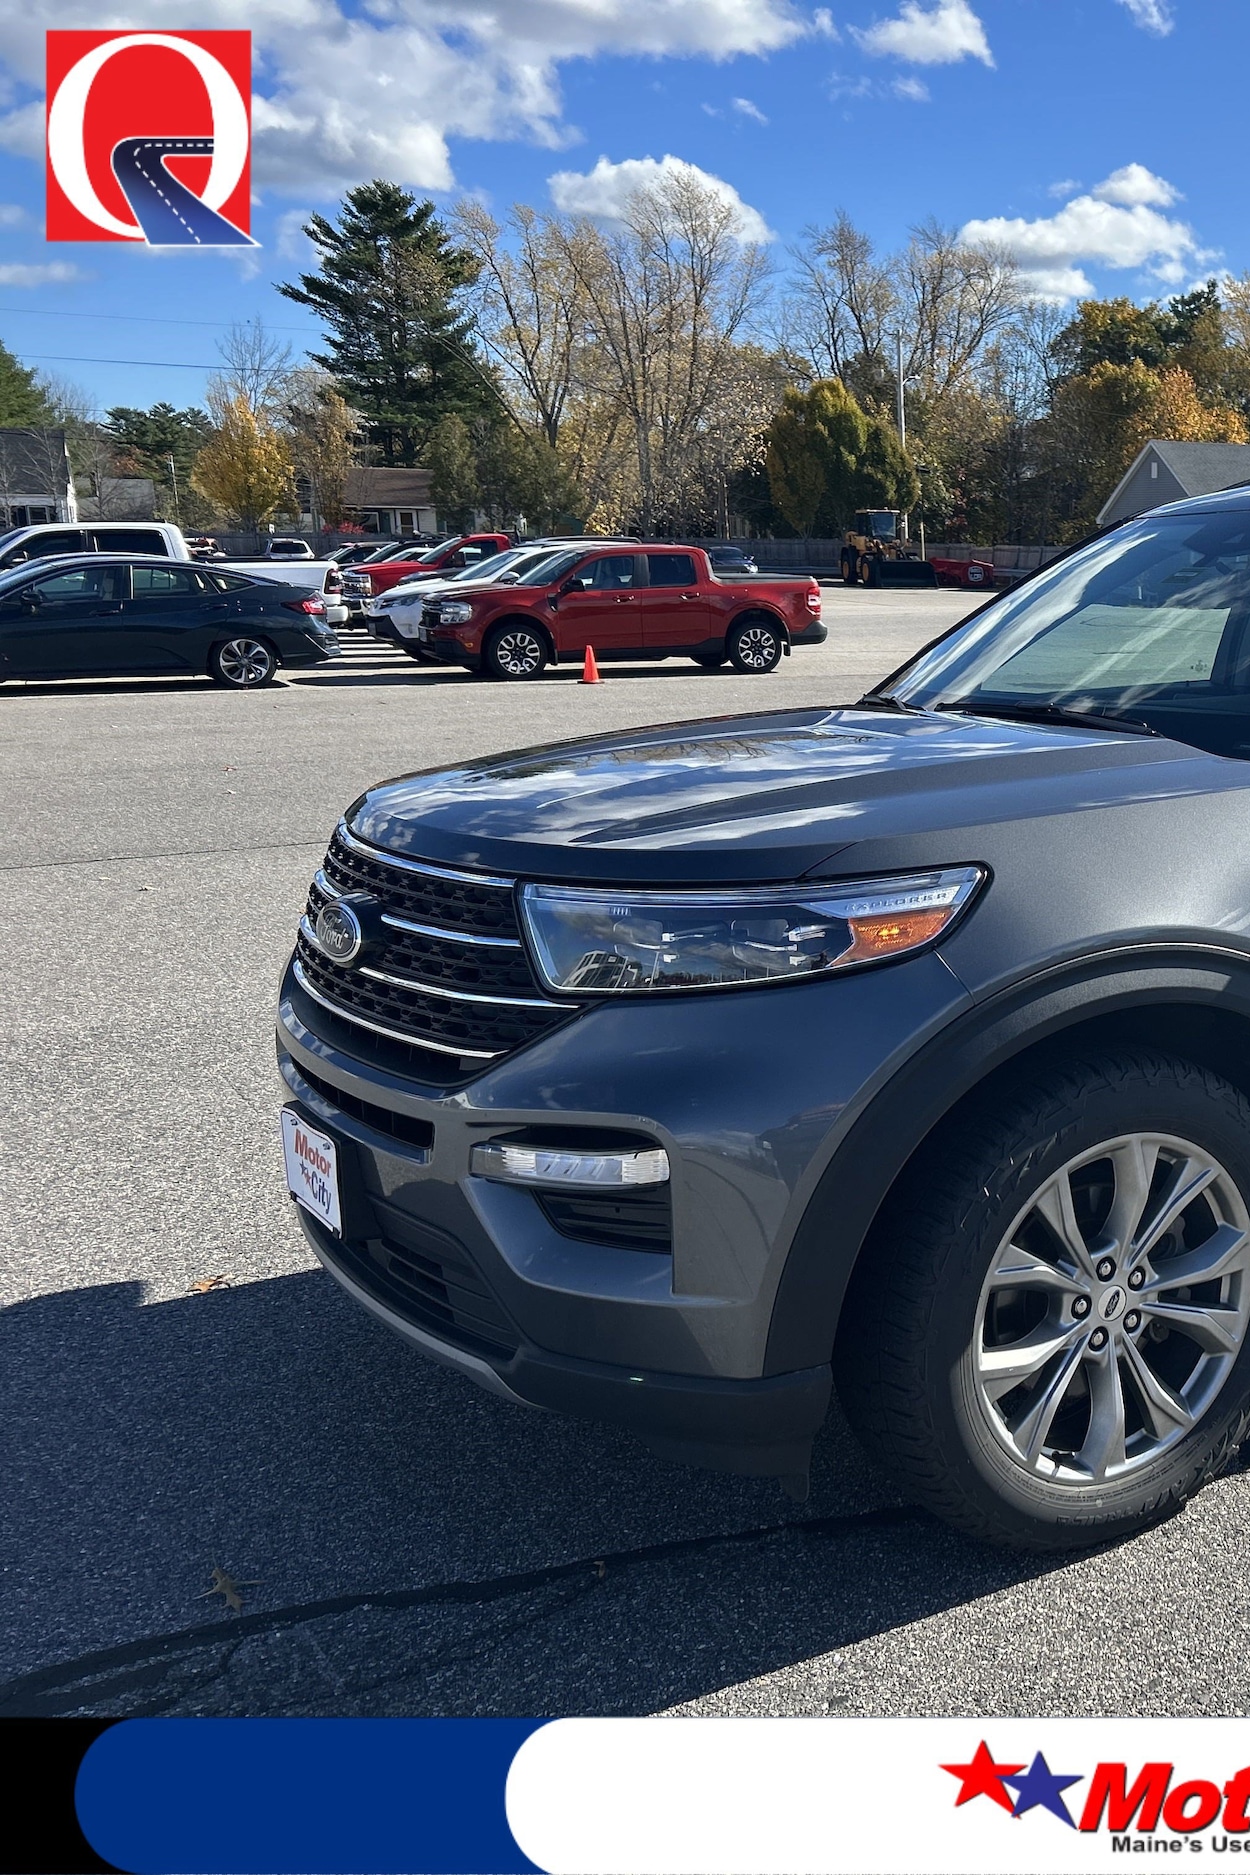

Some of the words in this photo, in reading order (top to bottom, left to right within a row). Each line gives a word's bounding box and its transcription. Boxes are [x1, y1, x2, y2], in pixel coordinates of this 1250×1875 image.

[321, 911, 348, 949] Ford
[294, 1128, 332, 1178] Motor
[311, 1170, 332, 1215] City
